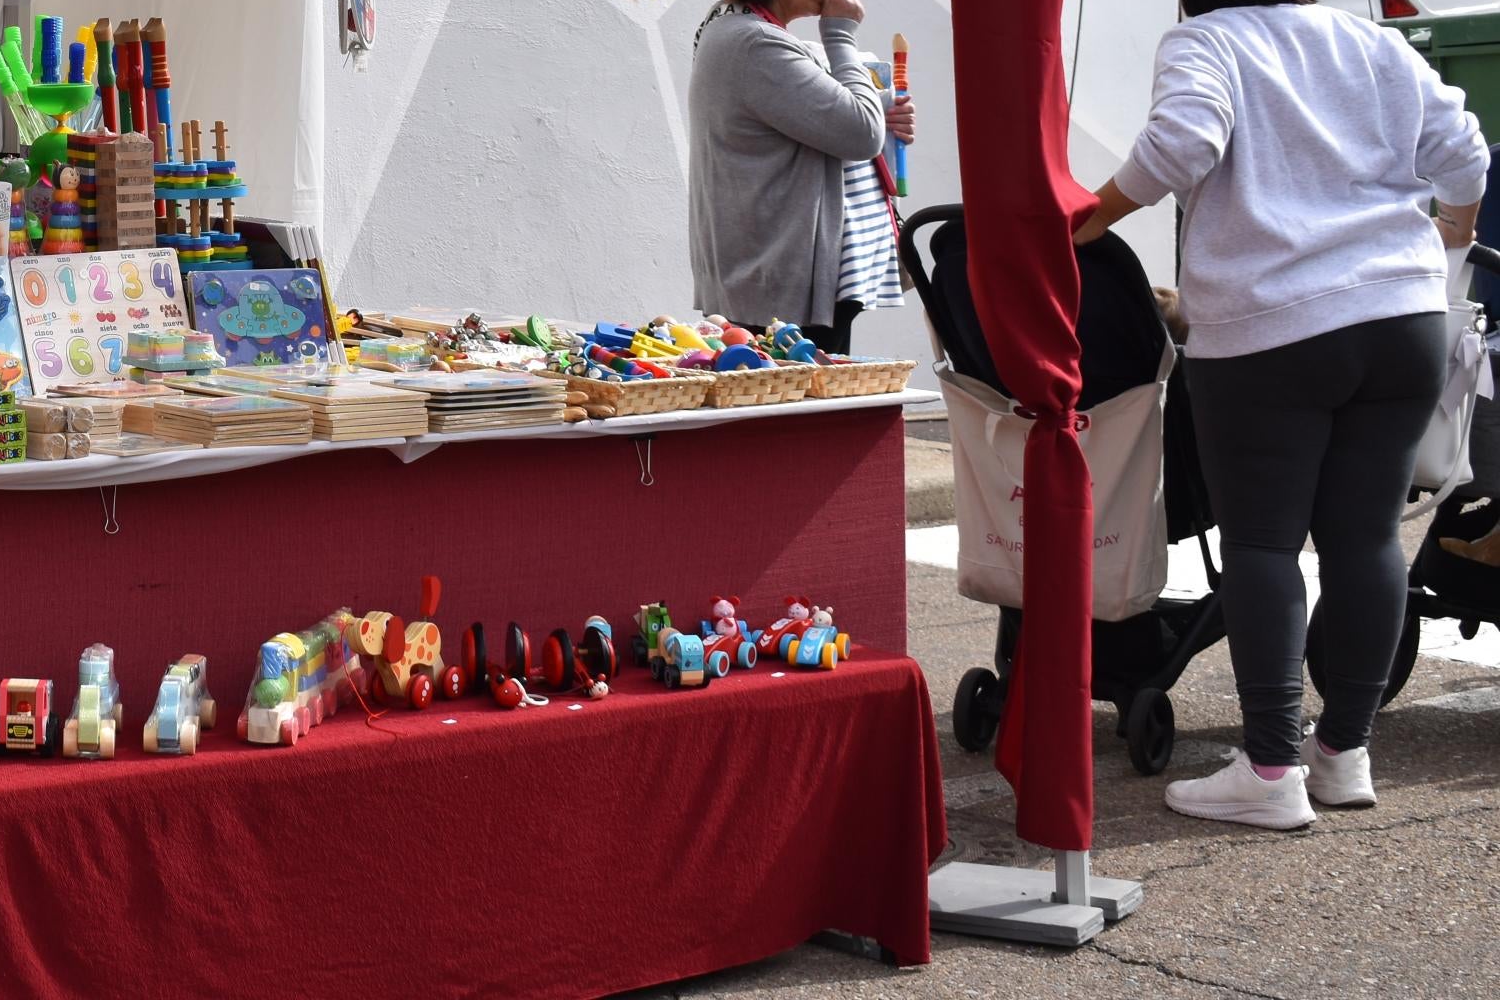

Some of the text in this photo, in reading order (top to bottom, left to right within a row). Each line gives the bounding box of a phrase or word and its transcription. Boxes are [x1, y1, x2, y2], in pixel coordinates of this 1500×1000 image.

[22, 261, 175, 307] 0 1 2 3 4
[34, 329, 54, 337] cinco
[132, 322, 150, 330] ocho
[162, 320, 185, 328] nueve
[35, 337, 122, 378] 5 6 7
